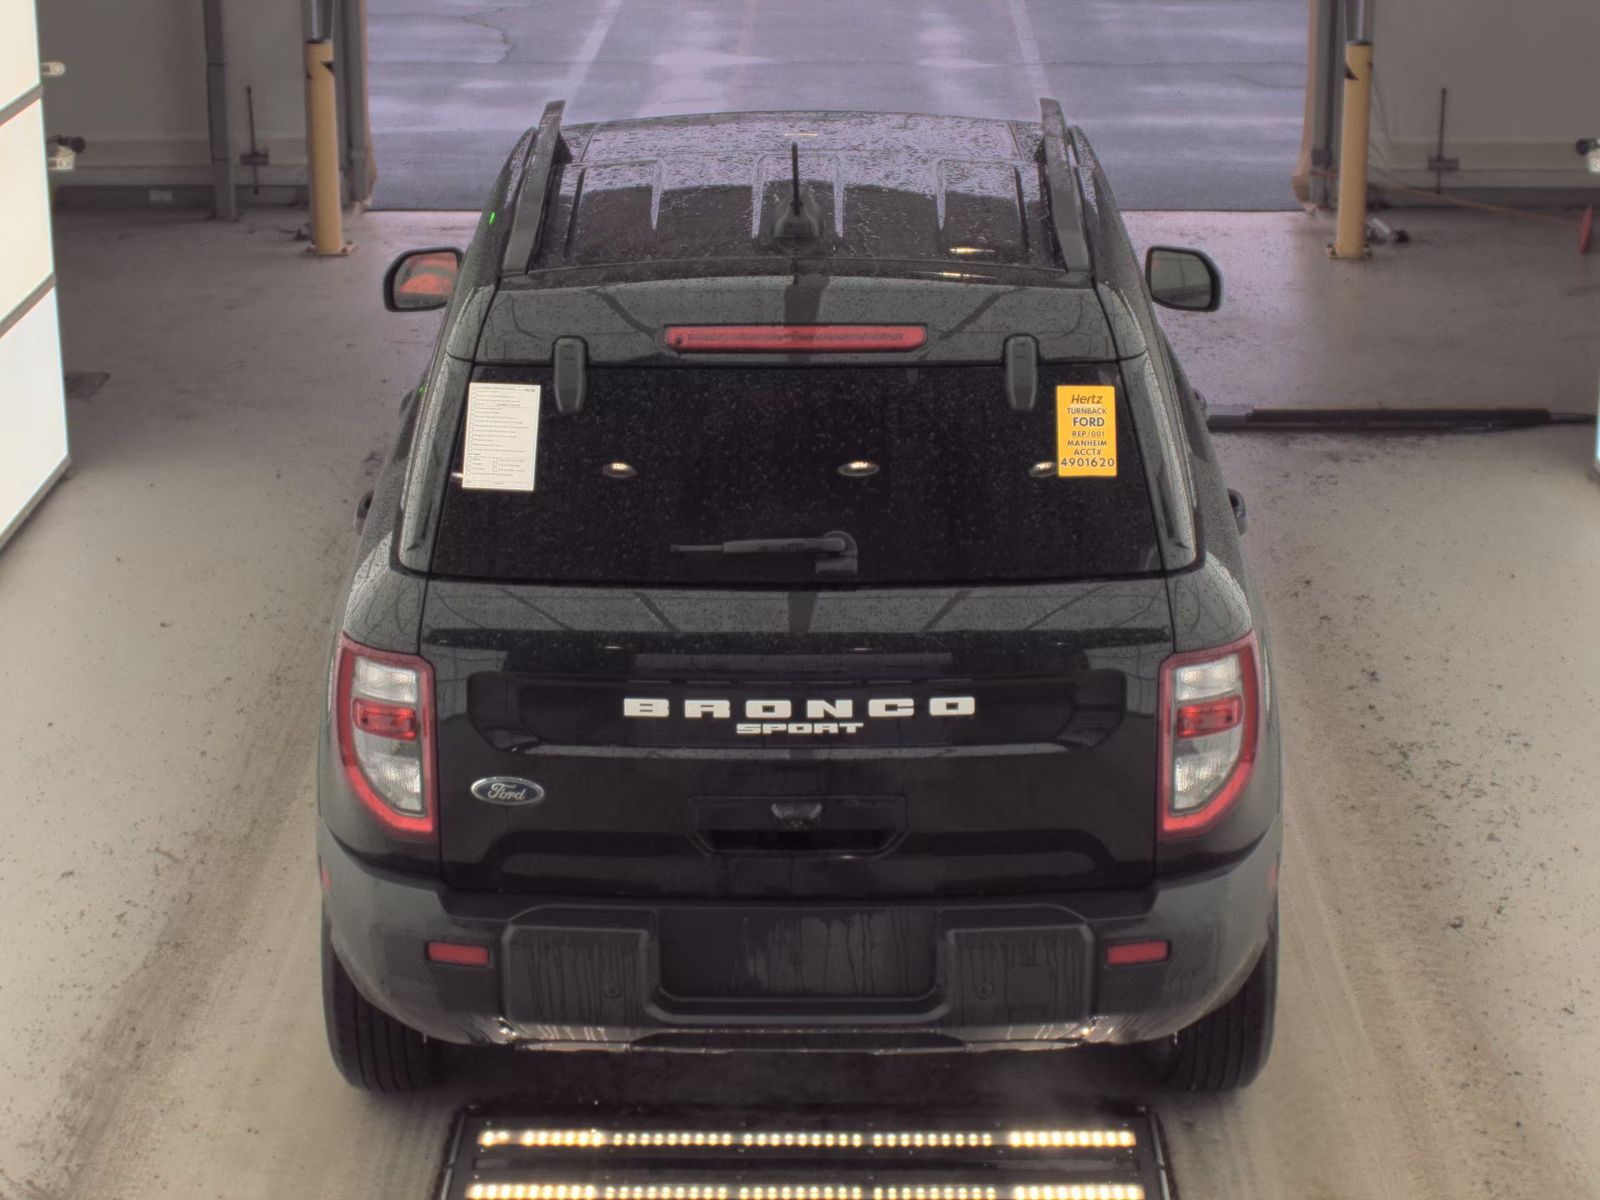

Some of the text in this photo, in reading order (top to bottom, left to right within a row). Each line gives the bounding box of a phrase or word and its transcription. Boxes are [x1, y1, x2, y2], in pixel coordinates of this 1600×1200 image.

[1070, 394, 1103, 404] Hertz
[1072, 417, 1105, 427] FORD
[1060, 458, 1114, 467] 4901620
[624, 696, 976, 719] BRONCO
[736, 722, 864, 735] SPORT
[487, 782, 528, 800] Ford
